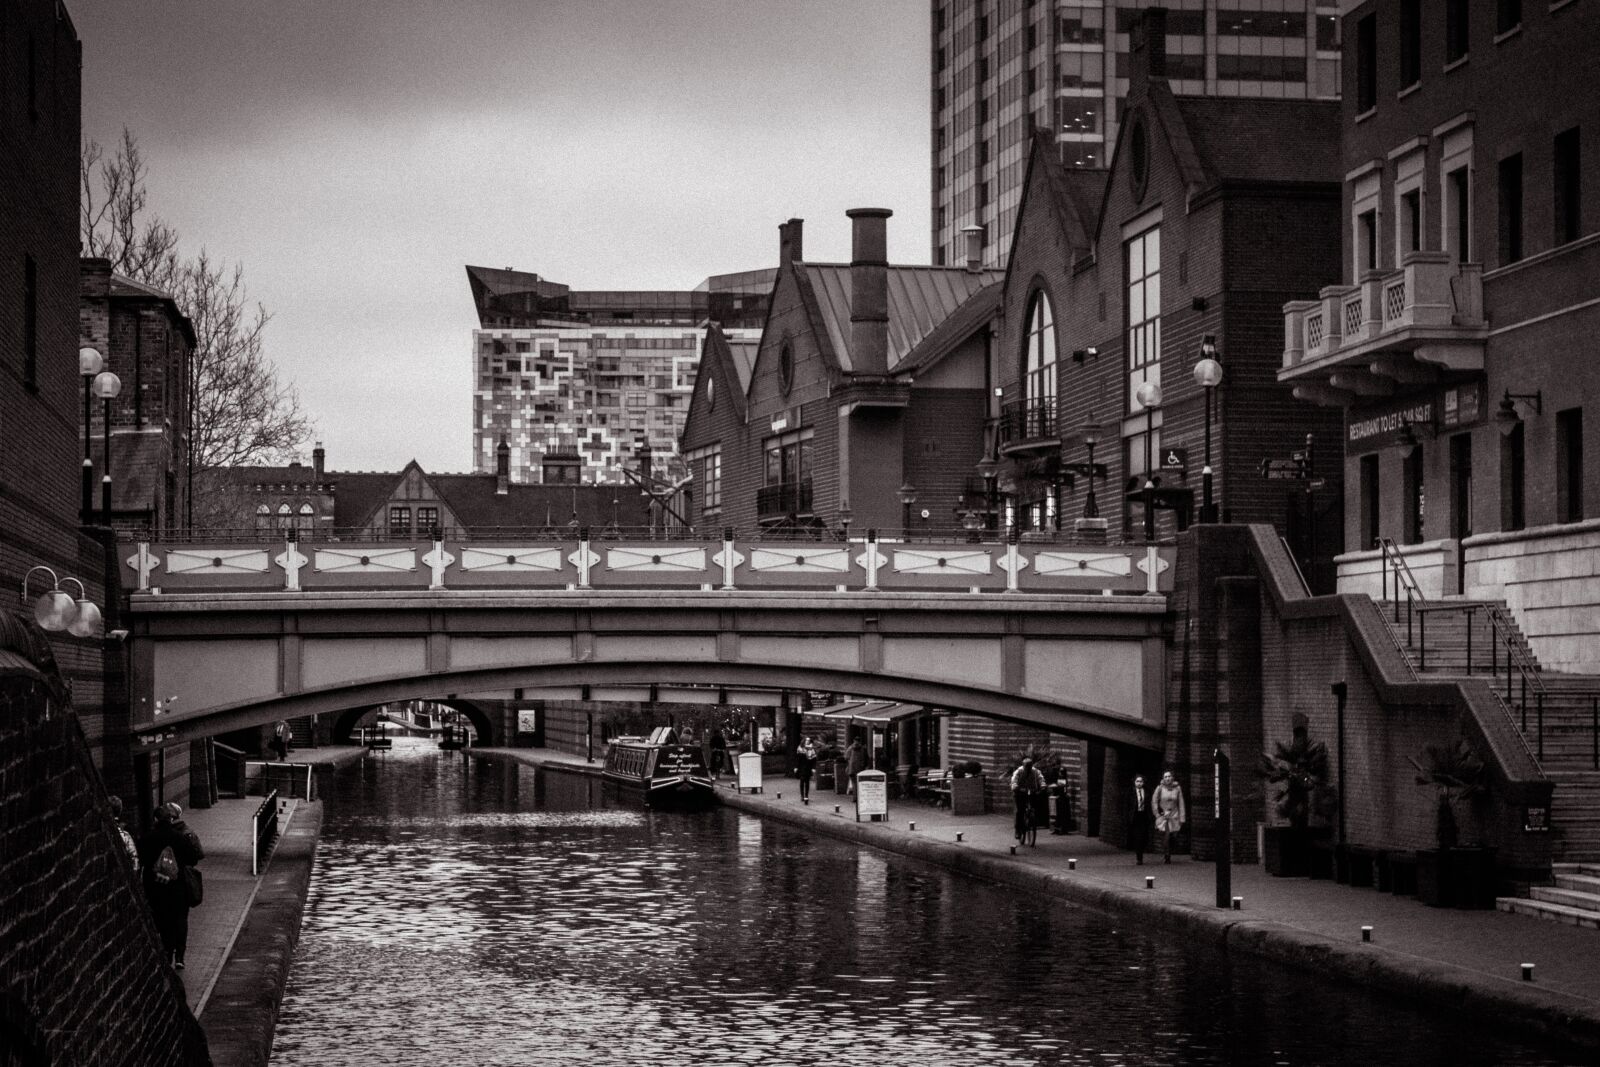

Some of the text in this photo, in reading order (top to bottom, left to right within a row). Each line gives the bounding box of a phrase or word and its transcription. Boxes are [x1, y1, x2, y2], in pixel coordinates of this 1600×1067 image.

[1349, 418, 1380, 441] RESTAURANT
[1380, 415, 1388, 432] TO
[1388, 412, 1397, 431] LET
[1424, 404, 1431, 421] FT
